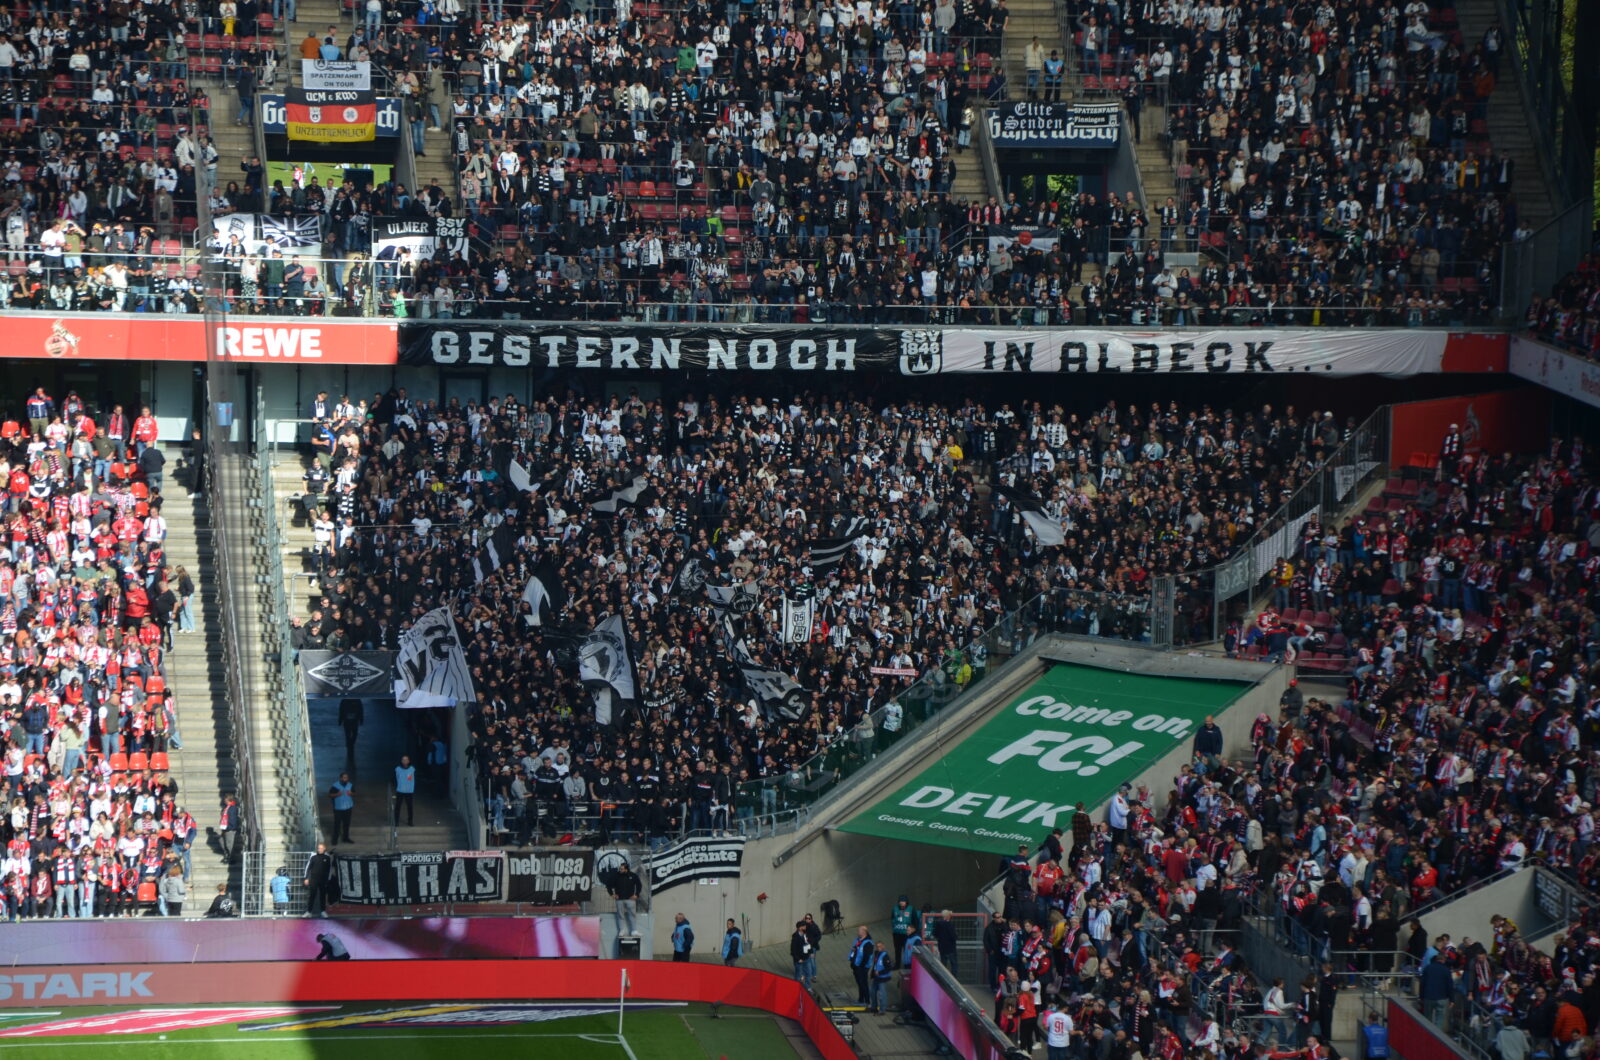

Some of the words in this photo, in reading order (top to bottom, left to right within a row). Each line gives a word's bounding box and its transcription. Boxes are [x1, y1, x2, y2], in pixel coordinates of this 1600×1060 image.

[1014, 102, 1053, 116] Elite
[1004, 115, 1063, 130] Senden
[387, 222, 429, 234] ULMER
[436, 227, 464, 237] 1846
[437, 217, 465, 228] SSV
[216, 328, 322, 358] REWE
[901, 330, 940, 343] SSV
[431, 331, 681, 369] GESTERN
[707, 338, 856, 371] NOCH
[901, 342, 940, 355] 1846
[984, 341, 1034, 372] IN
[1015, 695, 1133, 727] Come
[1132, 714, 1194, 740] on,
[987, 730, 1145, 777] FC!
[899, 786, 1078, 828] DEVK
[401, 854, 442, 864] PRODIGYS
[510, 854, 584, 876] nebulosa
[656, 850, 737, 878] constante
[340, 858, 495, 899] ULTRAS
[535, 874, 590, 900] impero
[1054, 1020, 1065, 1033] 91
